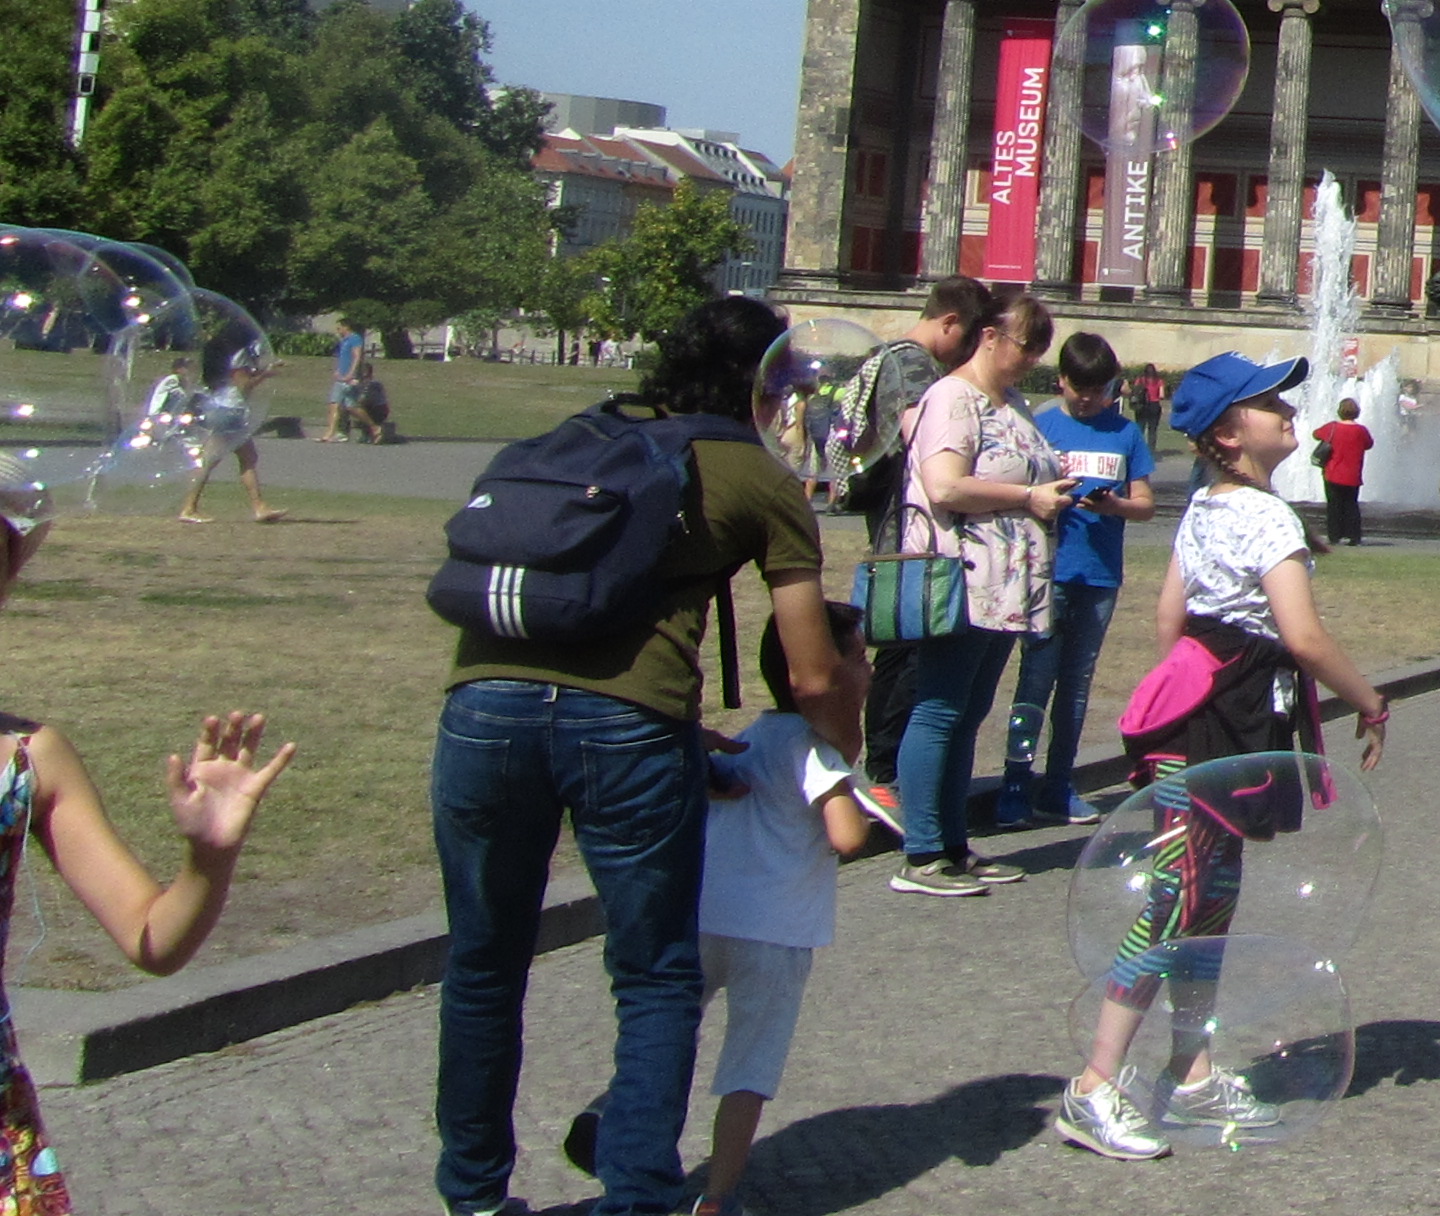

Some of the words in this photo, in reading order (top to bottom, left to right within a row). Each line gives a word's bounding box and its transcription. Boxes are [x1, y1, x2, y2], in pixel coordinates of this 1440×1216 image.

[993, 130, 1016, 205] ALTES
[1015, 67, 1045, 177] MUSEUM
[1122, 161, 1148, 261] ANTIKE
